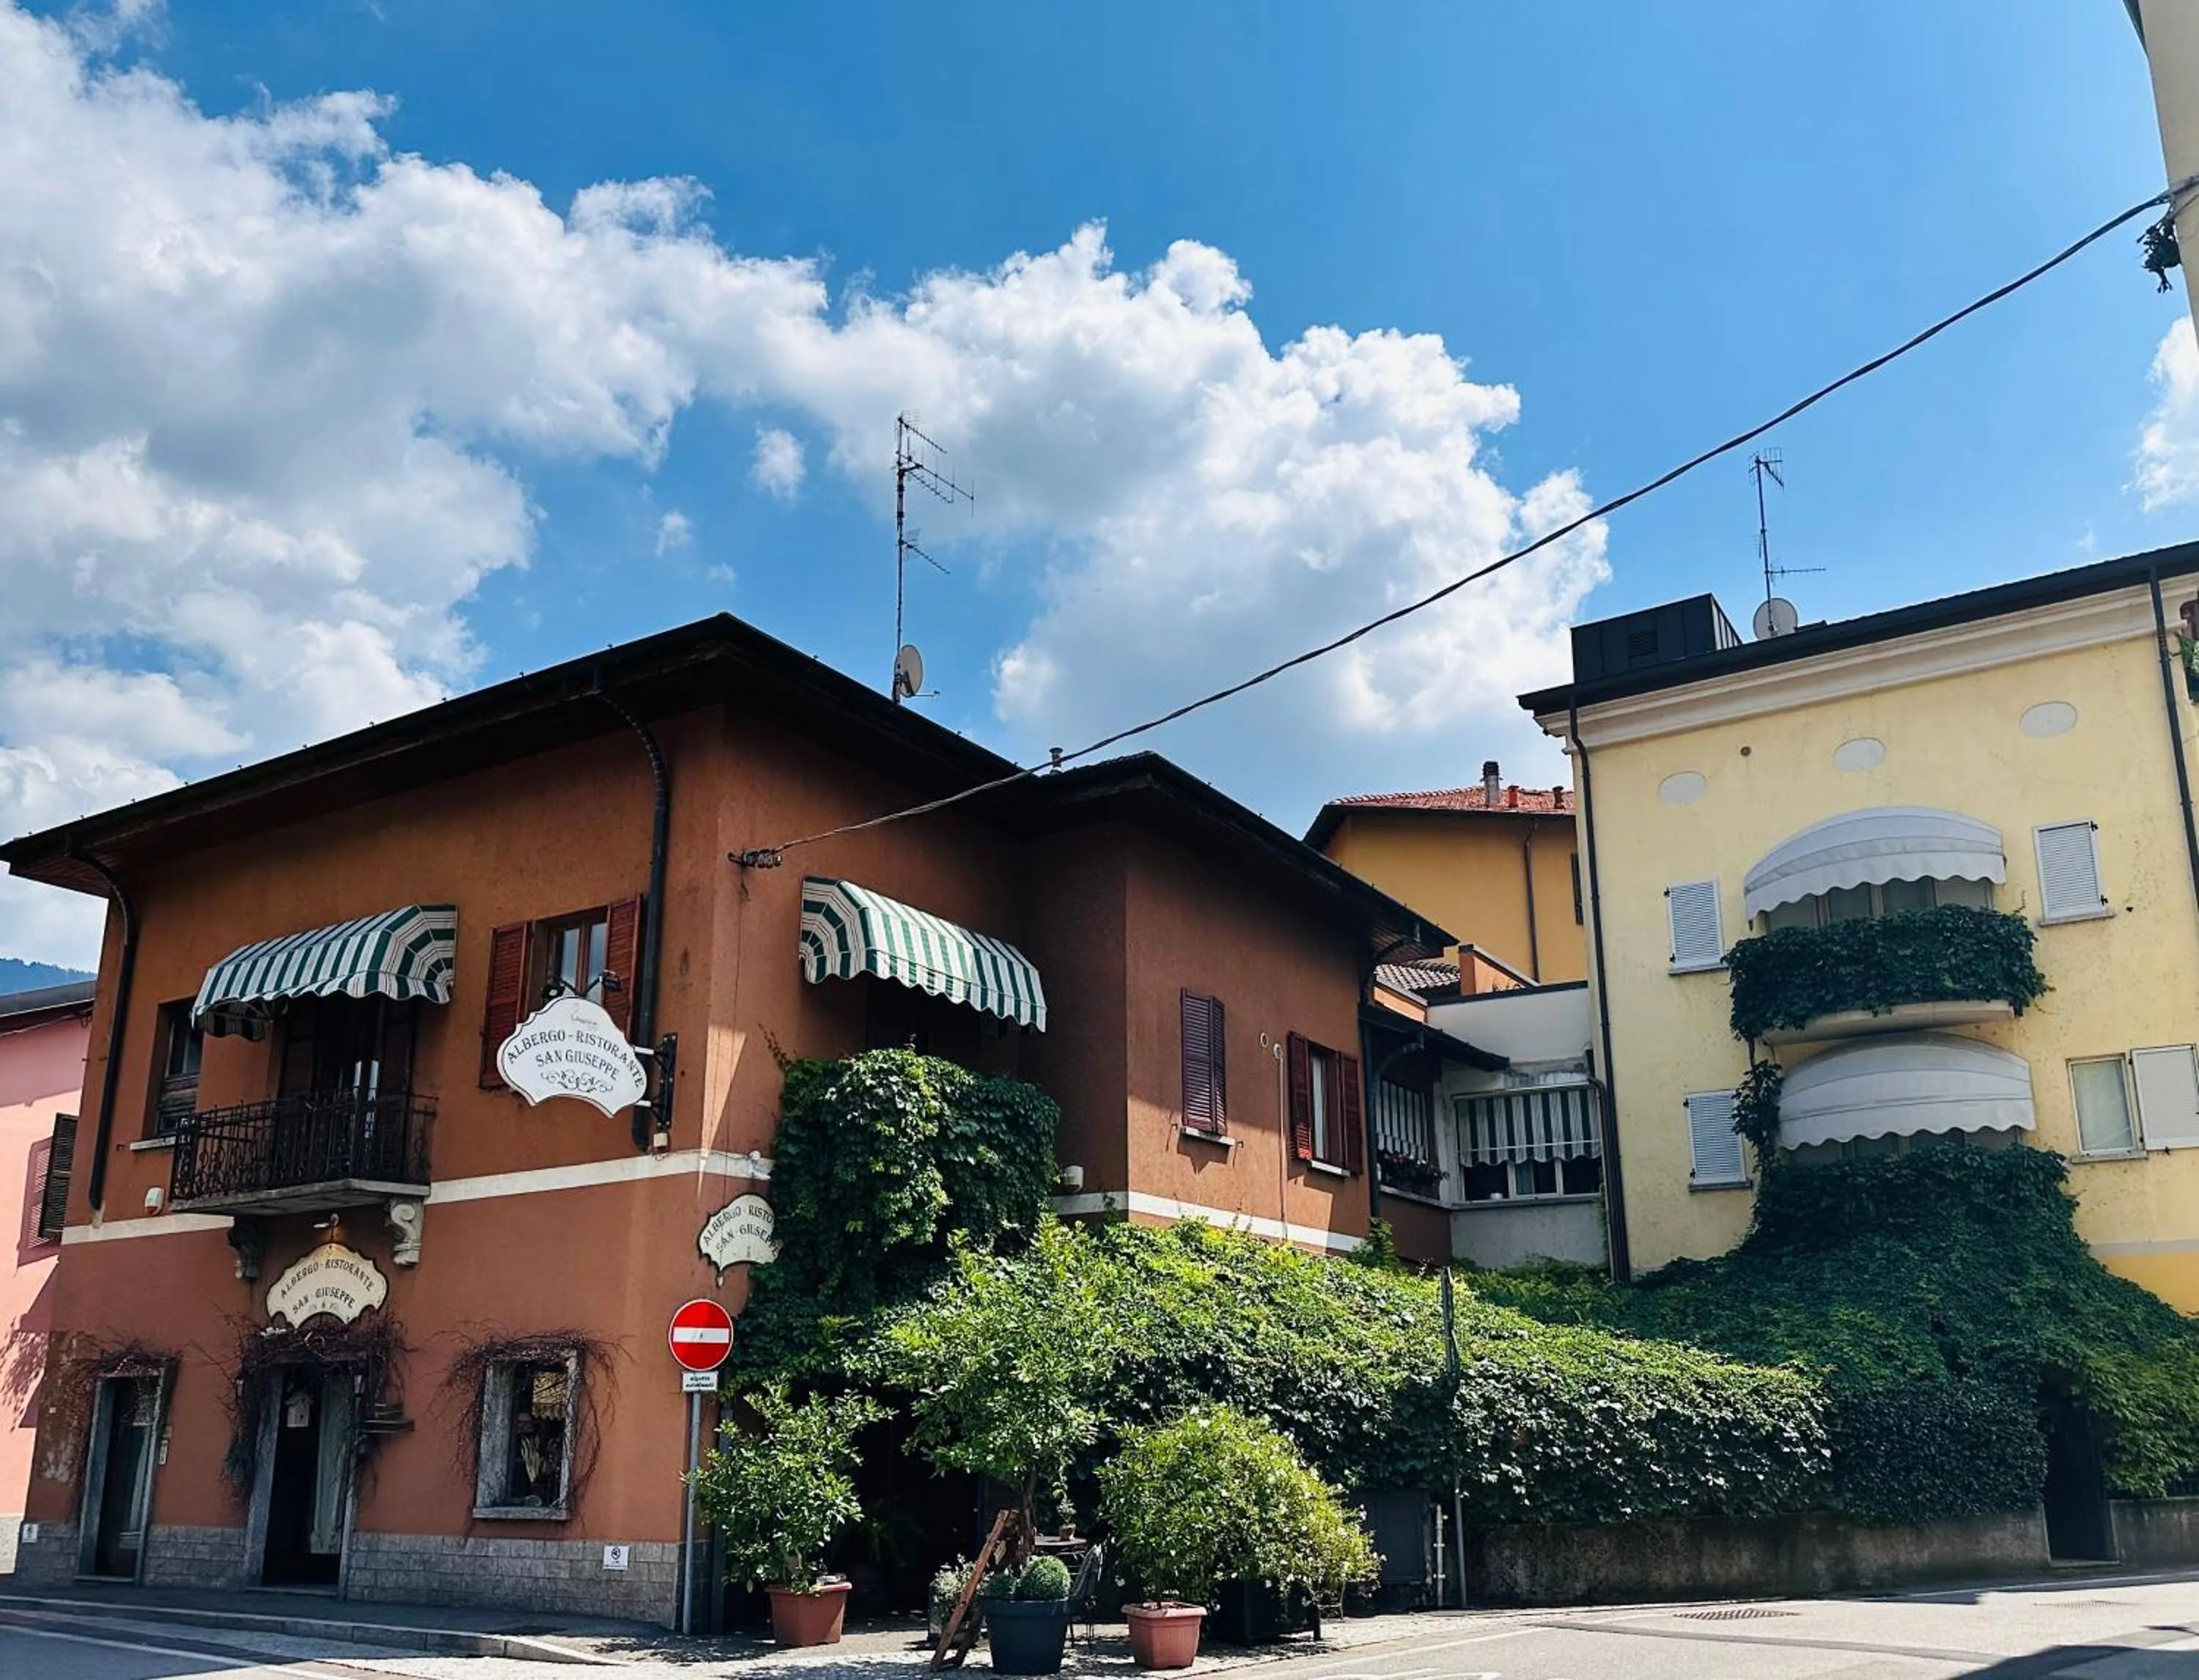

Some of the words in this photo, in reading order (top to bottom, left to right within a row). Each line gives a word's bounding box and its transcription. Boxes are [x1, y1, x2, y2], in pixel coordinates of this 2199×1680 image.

[507, 1030, 566, 1064] ALBERGO
[576, 1030, 644, 1088] RISTORANTE
[536, 1049, 562, 1067] SAN
[565, 1049, 619, 1081] GIUSEPPE
[704, 1206, 741, 1245] ALBERGO
[748, 1204, 774, 1223] RISTO
[715, 1228, 734, 1253] SAN
[739, 1223, 779, 1257] GIUSEPPE
[281, 1261, 319, 1299] ALBERGO
[325, 1259, 374, 1292] RISTORANTE
[293, 1293, 309, 1314] SAN
[315, 1286, 356, 1308] GIUSEPPE
